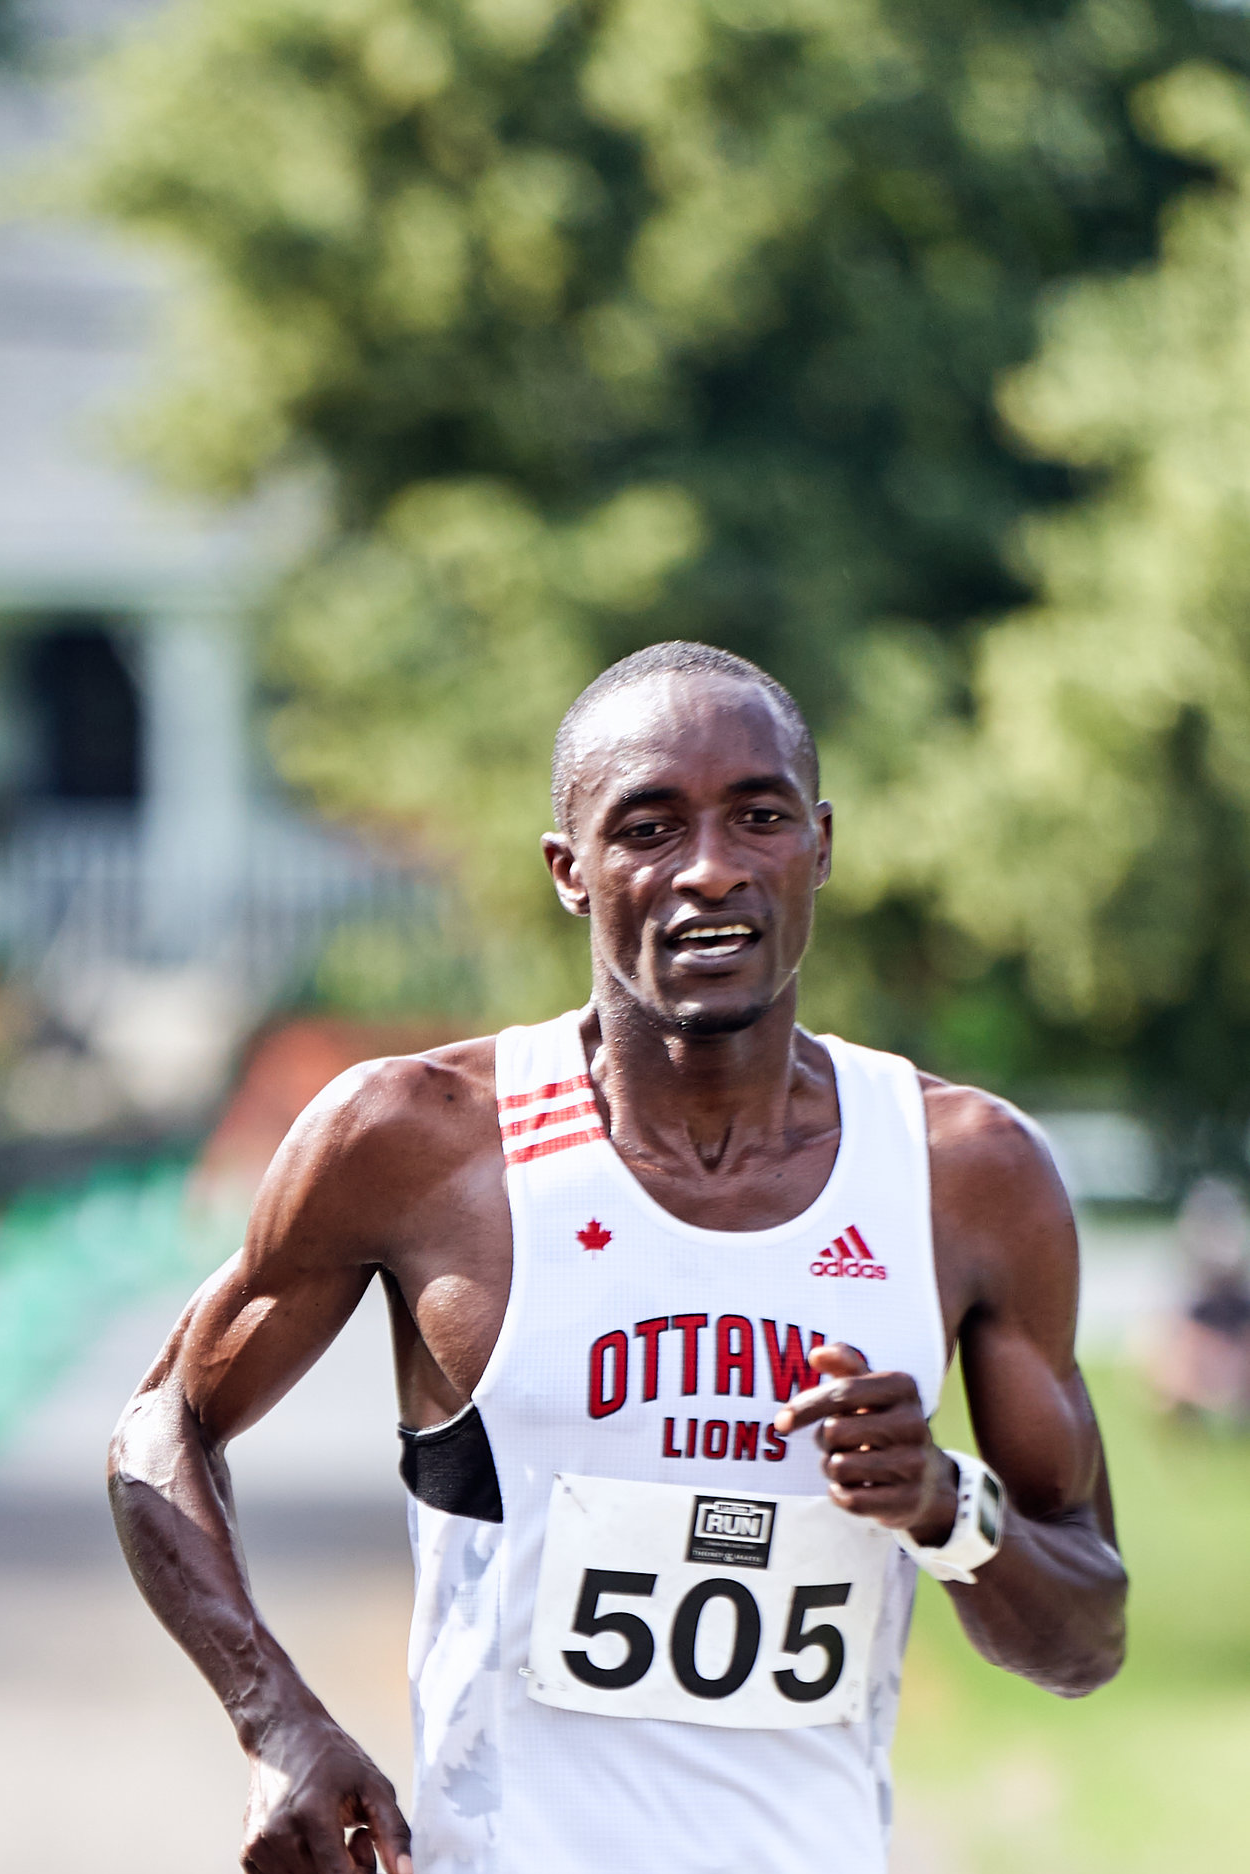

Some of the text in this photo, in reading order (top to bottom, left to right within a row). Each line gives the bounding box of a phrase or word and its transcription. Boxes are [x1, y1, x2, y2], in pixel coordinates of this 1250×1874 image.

[810, 1259, 886, 1280] adidas
[588, 1313, 871, 1419] OTTAW
[662, 1416, 787, 1461] LIONS
[705, 1513, 761, 1536] RUN
[561, 1568, 852, 1702] 505
